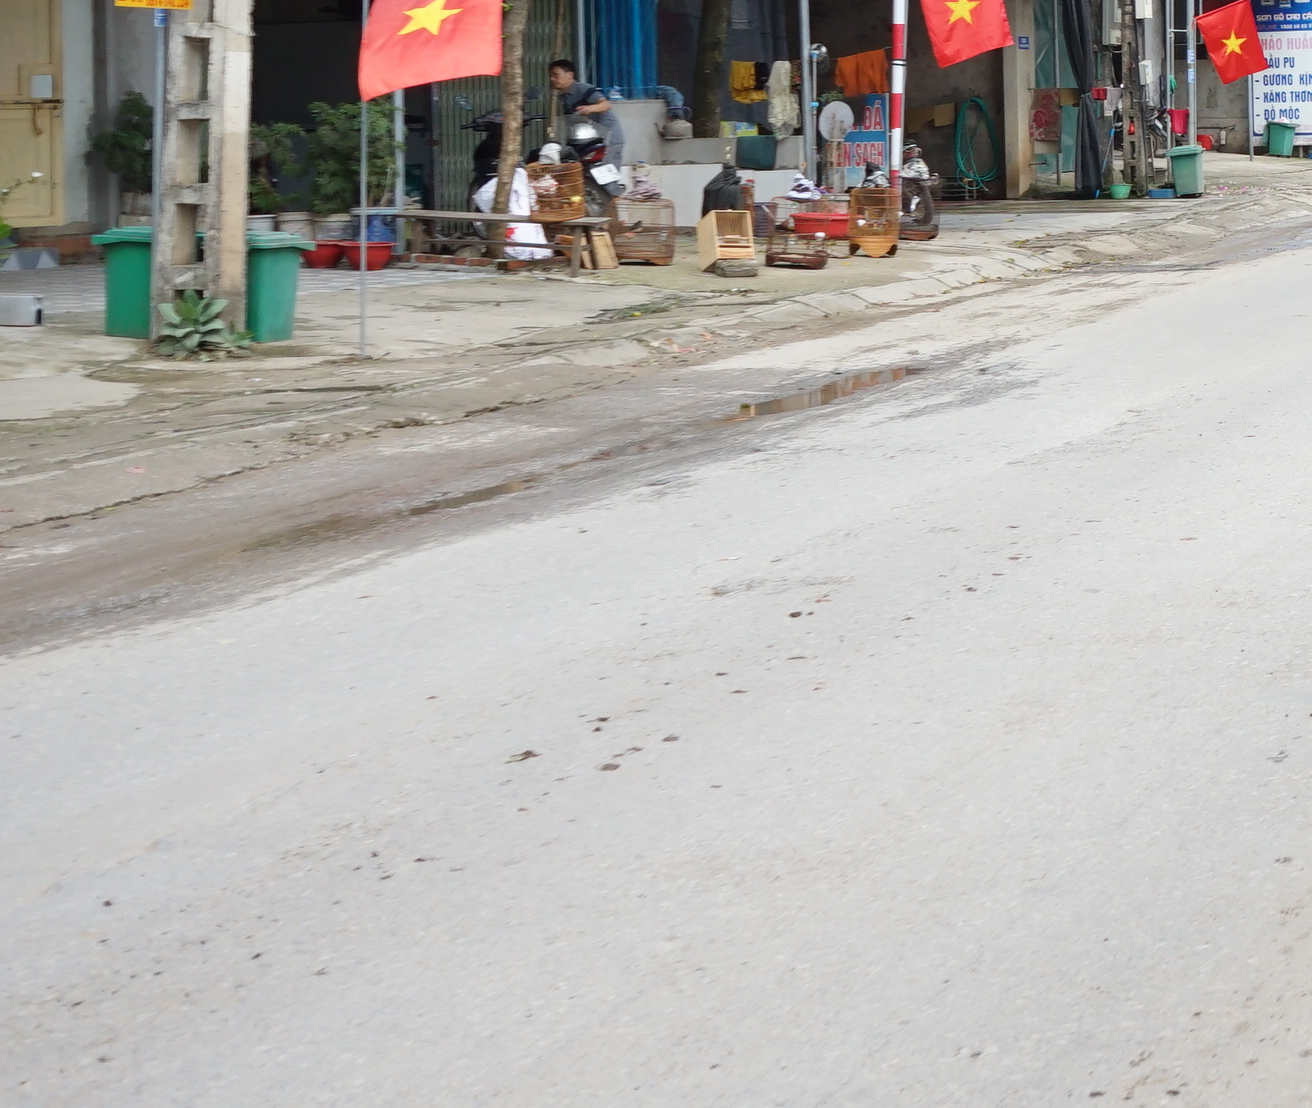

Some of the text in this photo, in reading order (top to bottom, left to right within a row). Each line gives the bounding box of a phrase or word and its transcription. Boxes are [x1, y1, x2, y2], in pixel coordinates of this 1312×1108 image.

[1284, 57, 1295, 68] PU
[1263, 73, 1293, 86] GƯƠNG
[863, 99, 885, 132] ĐÁ
